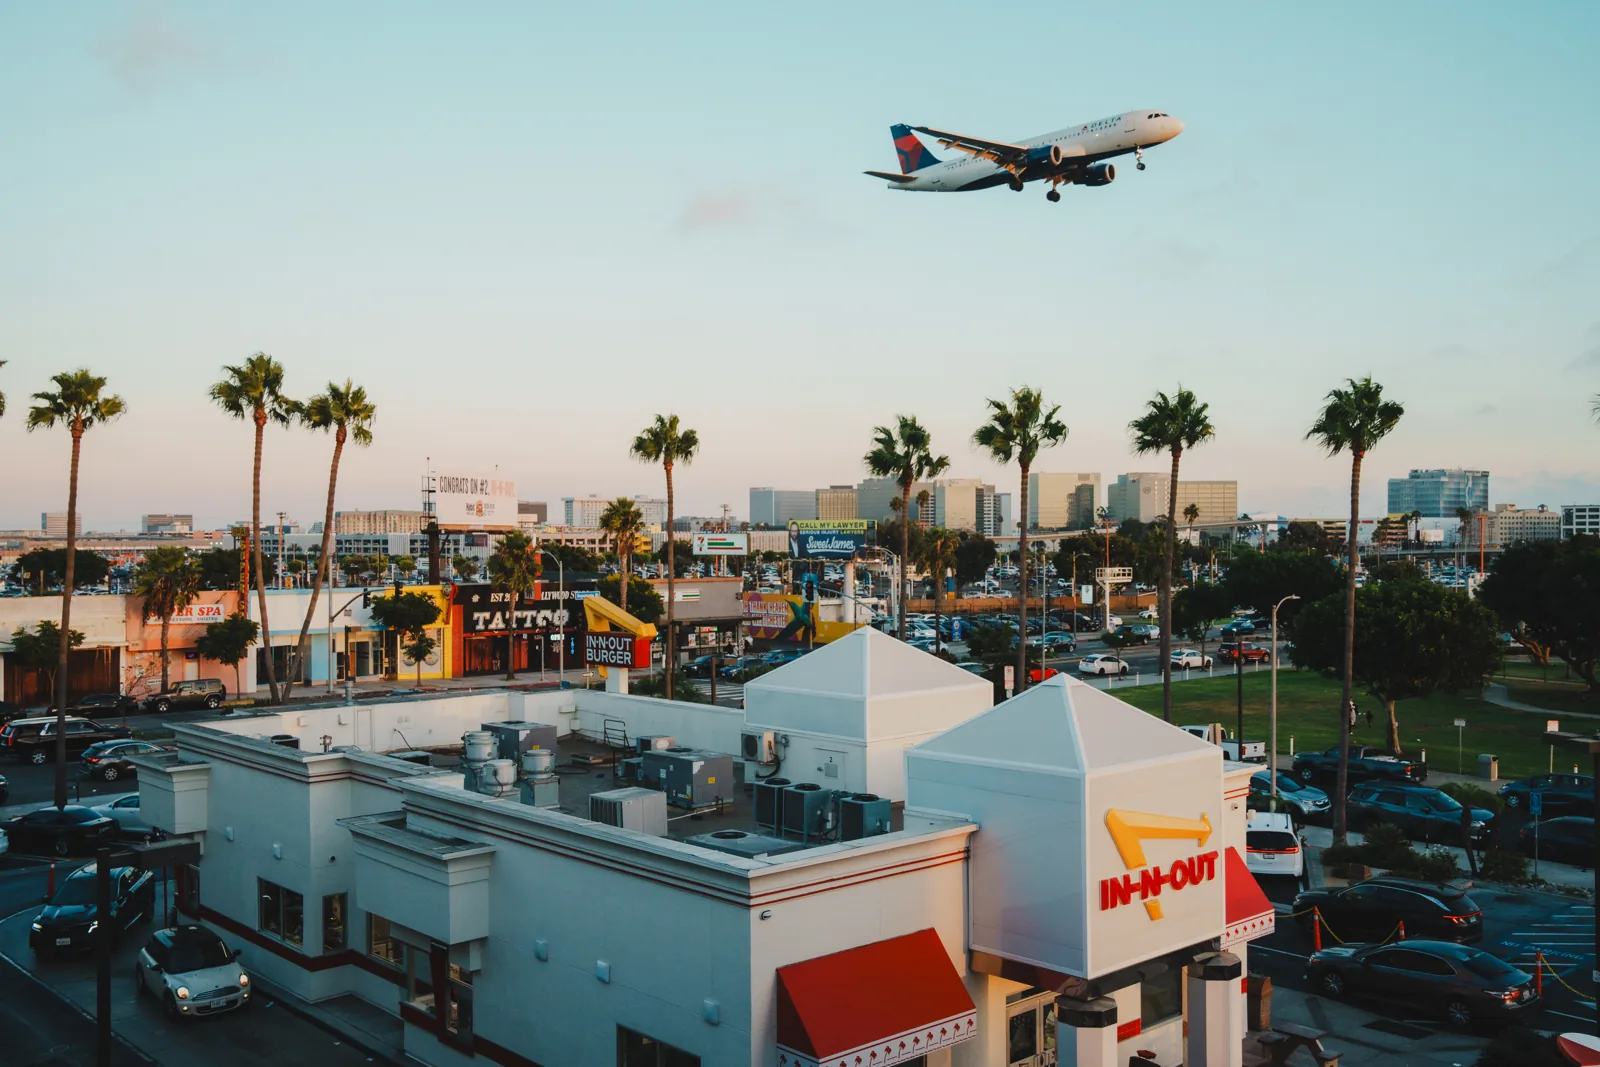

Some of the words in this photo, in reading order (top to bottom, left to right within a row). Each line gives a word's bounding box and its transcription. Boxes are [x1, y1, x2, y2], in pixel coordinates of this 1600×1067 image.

[1090, 116, 1121, 128] DELTA
[440, 476, 468, 495] CONGRATS
[470, 478, 478, 494] ON
[832, 522, 864, 530] LAWYER
[491, 593, 503, 602] EST
[198, 606, 222, 616] SPA
[750, 601, 768, 614] THANK
[768, 602, 788, 616] HEAVEN
[586, 635, 632, 650] IN-N-OUT
[586, 648, 632, 664] BURGER
[1100, 850, 1219, 911] IN-N-OUT
